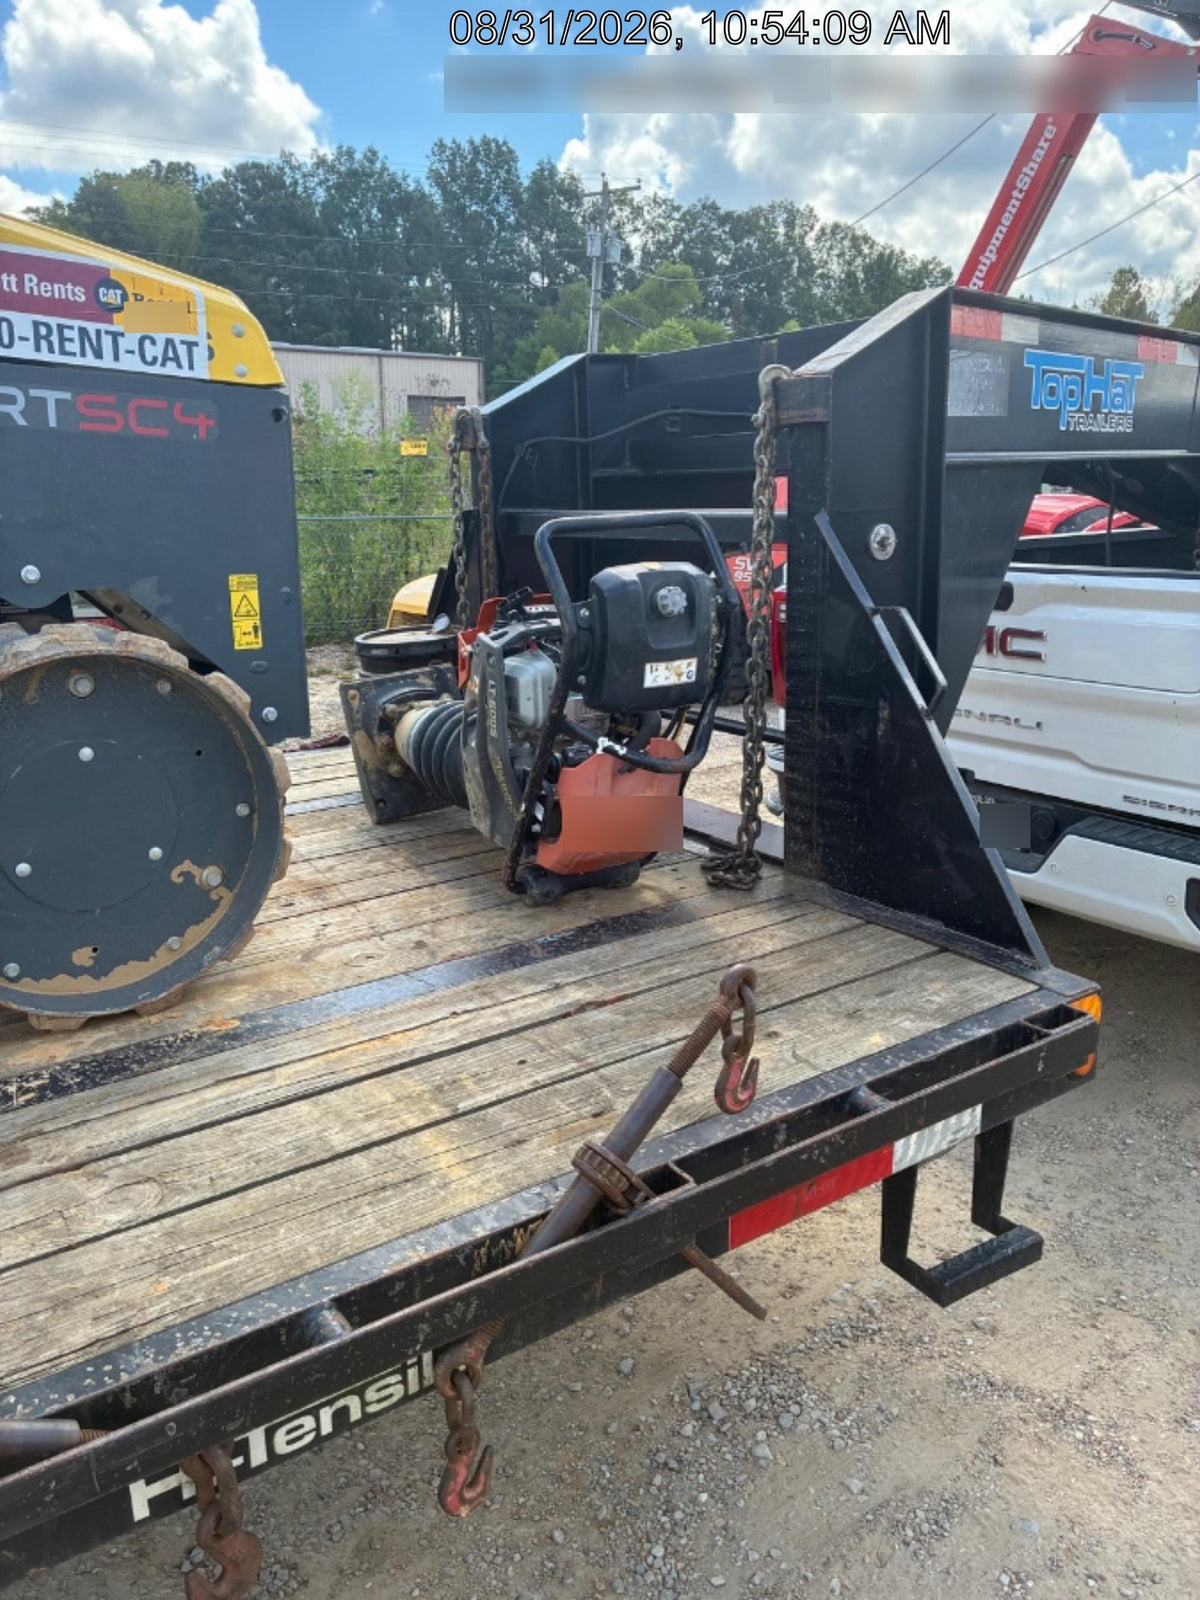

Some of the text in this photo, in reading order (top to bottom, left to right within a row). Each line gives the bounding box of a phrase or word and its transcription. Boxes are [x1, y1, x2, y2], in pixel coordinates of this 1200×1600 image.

[23, 273, 86, 303] Rents
[98, 286, 123, 305] CAT
[1067, 412, 1134, 433] TRAILERS
